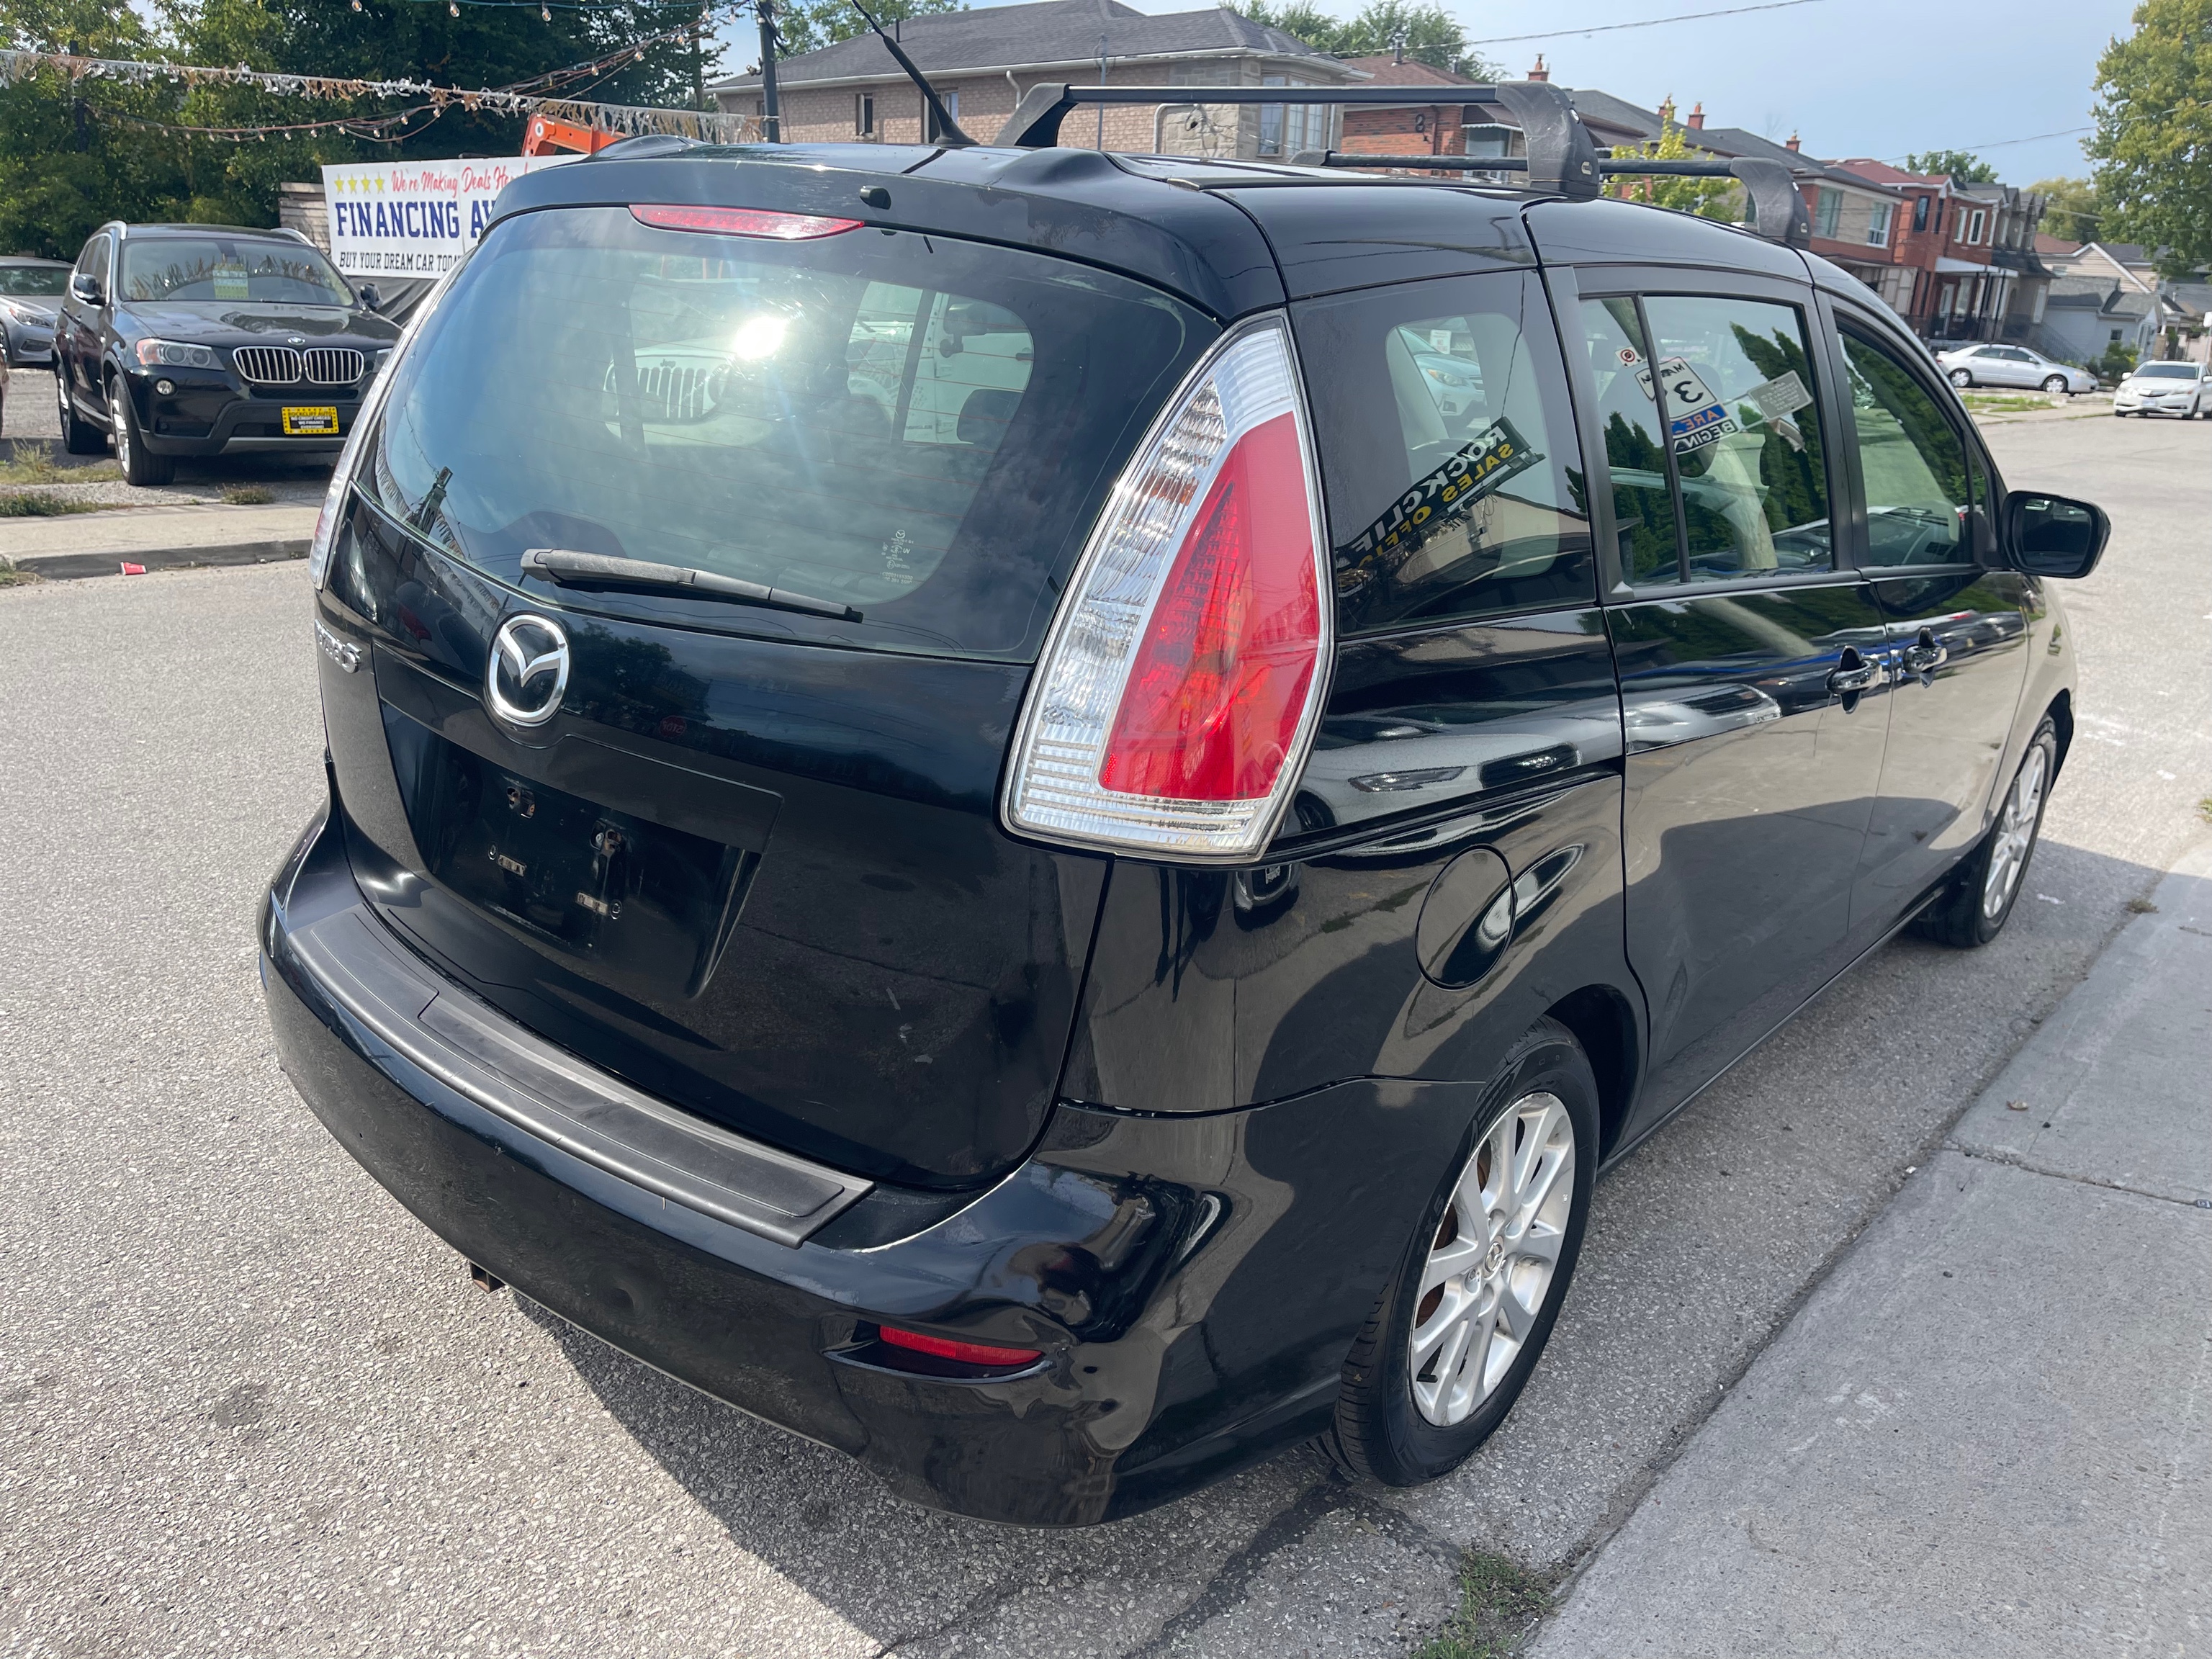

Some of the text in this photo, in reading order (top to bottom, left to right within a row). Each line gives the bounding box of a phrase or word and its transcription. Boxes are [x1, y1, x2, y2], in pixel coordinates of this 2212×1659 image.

[421, 170, 458, 198] Making
[462, 166, 492, 192] Deals
[335, 201, 460, 238] FINANCING
[339, 252, 357, 268] BUY
[360, 252, 382, 269] YOUR
[384, 253, 413, 270] DREAM
[416, 254, 434, 271] CAR
